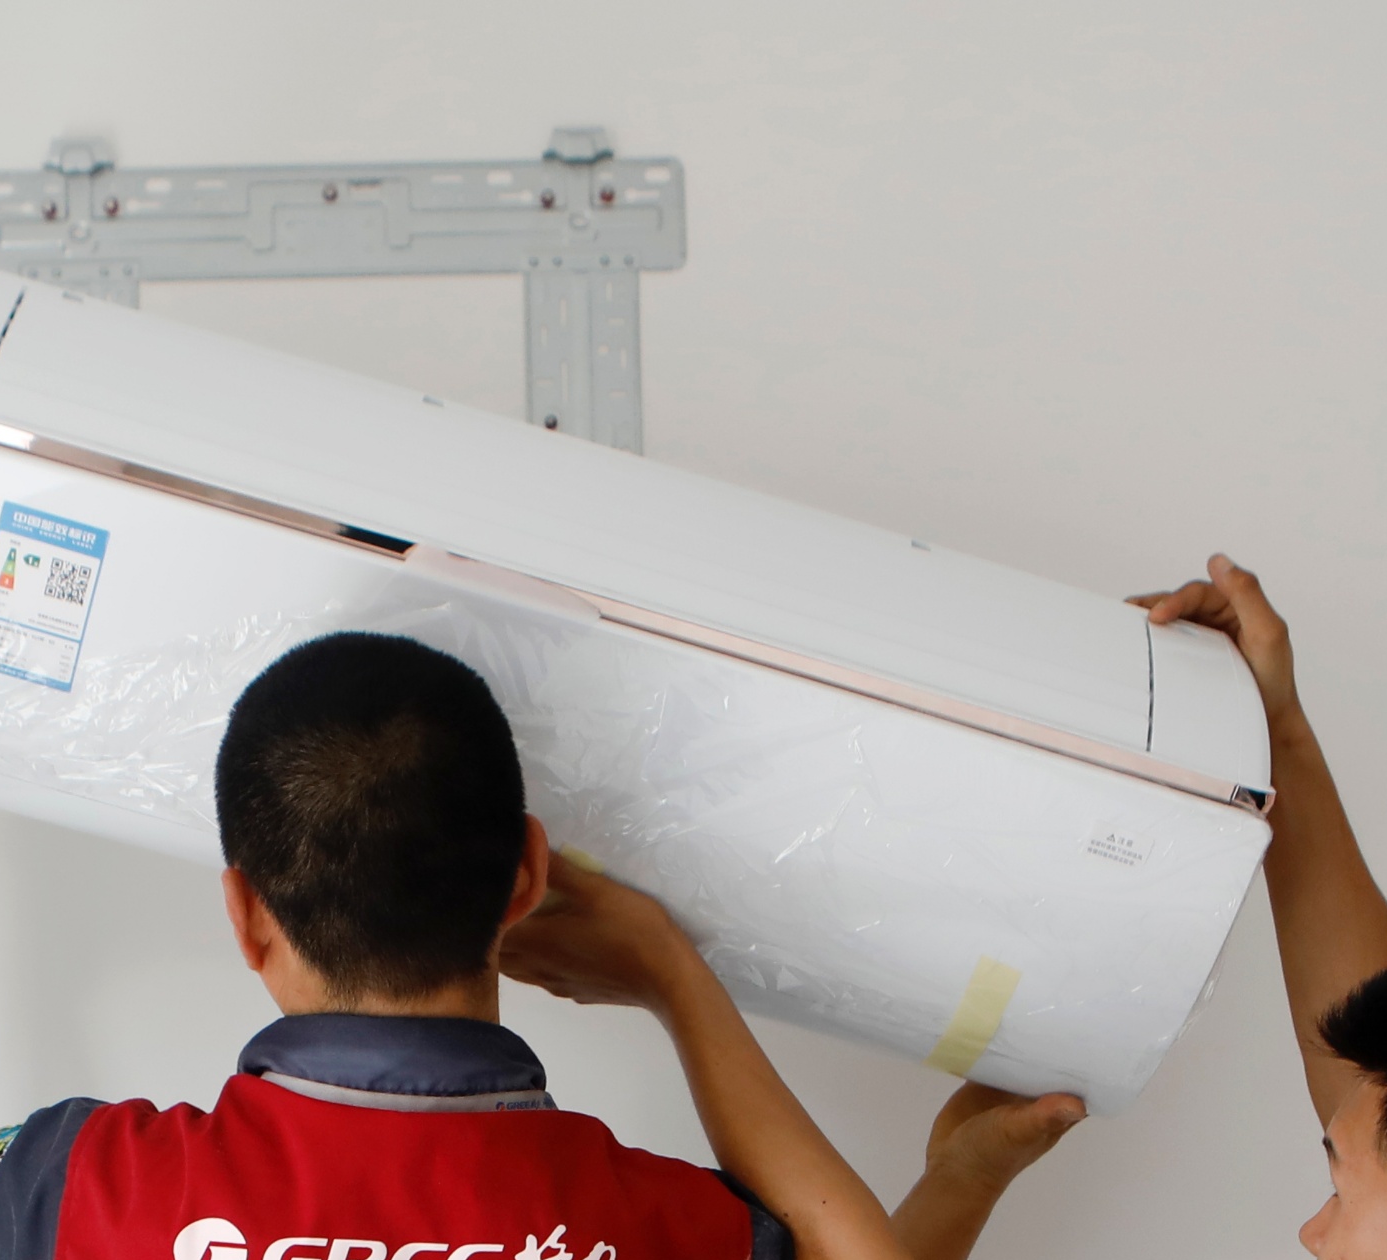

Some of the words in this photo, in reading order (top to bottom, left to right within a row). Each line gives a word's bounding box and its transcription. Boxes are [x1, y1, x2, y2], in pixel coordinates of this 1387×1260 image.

[13, 511, 96, 545] 中国能效标识
